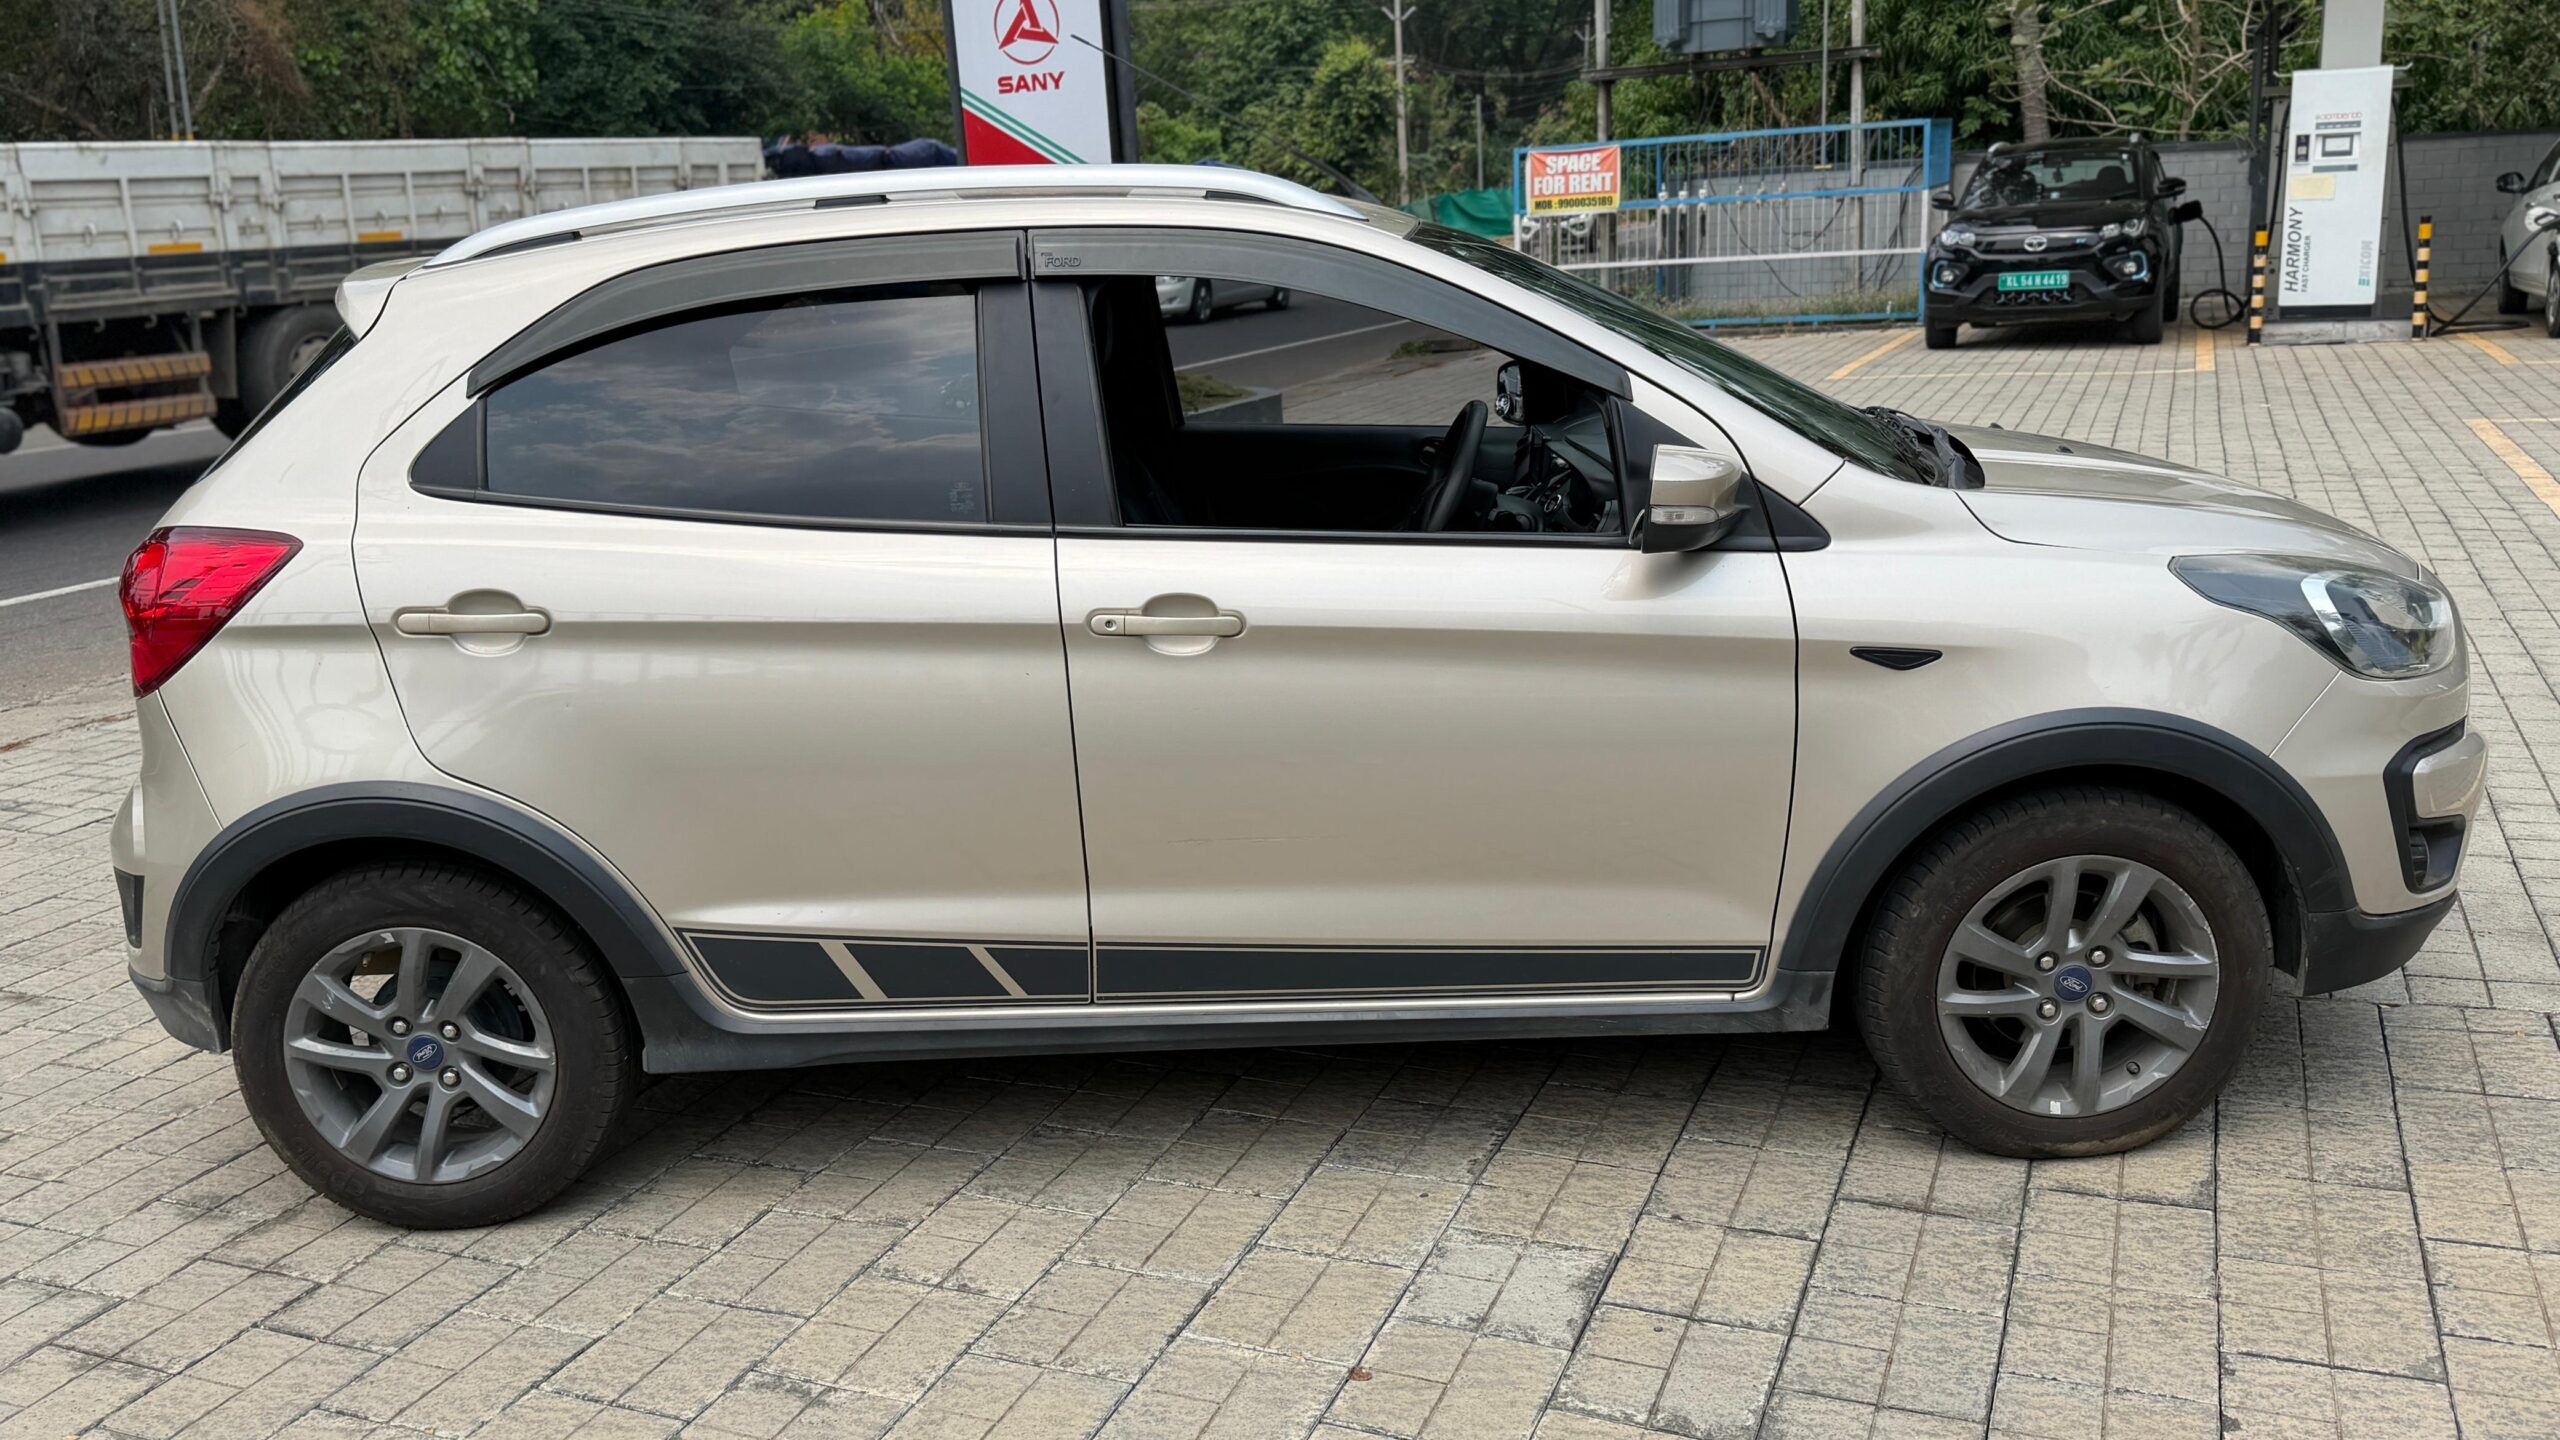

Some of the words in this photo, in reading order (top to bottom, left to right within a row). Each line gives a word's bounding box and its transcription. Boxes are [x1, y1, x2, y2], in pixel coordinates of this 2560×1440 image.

[997, 71, 1066, 94] SANY
[1546, 153, 1601, 174] SPACE
[1533, 176, 1566, 196] FOR
[1569, 172, 1614, 193] RENT
[2284, 206, 2303, 292] HARMONY
[2303, 235, 2311, 272] CHARGER
[1045, 257, 1081, 268] FORD
[2358, 240, 2373, 286] EXICOM
[2301, 274, 2309, 293] FAST
[2064, 978, 2084, 990] Ford
